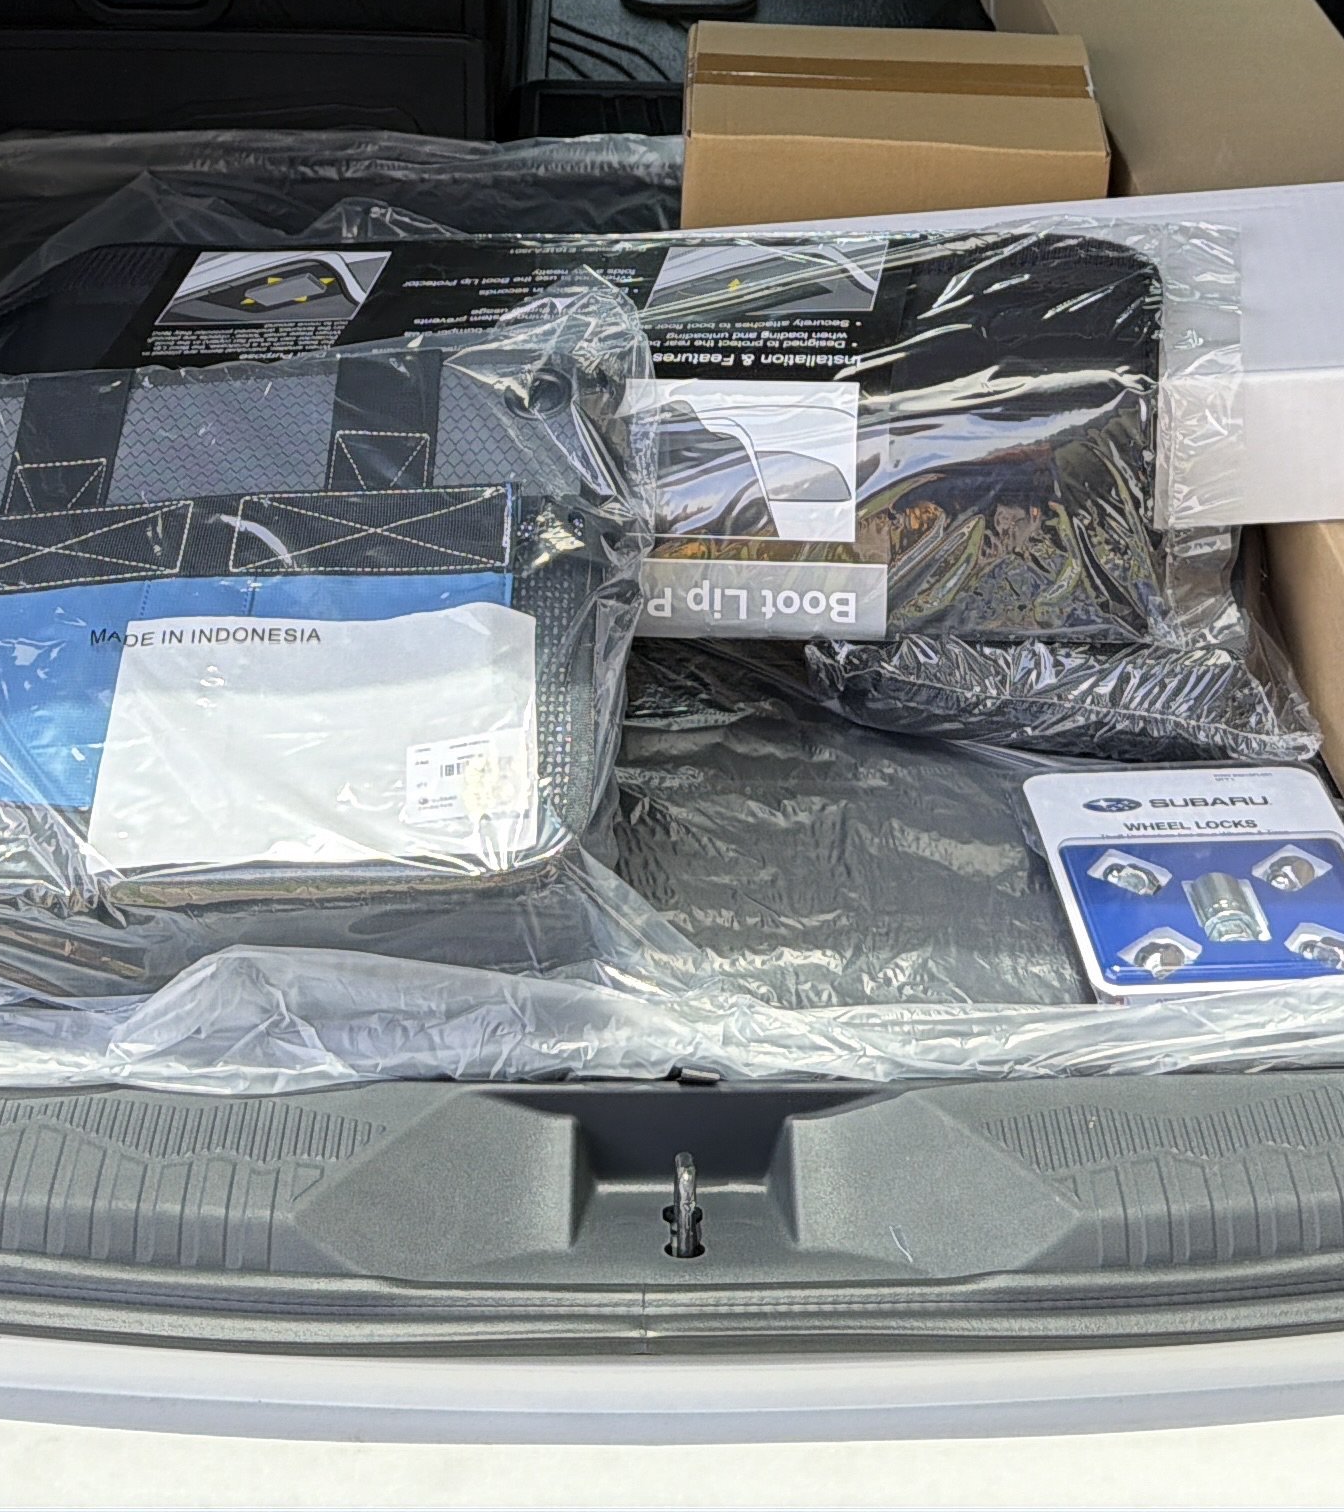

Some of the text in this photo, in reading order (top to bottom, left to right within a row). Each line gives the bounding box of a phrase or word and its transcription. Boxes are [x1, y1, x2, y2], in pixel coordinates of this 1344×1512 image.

[401, 279, 457, 288] Protector
[461, 278, 479, 286] Lip
[481, 277, 510, 285] Boot
[513, 275, 533, 283] the
[478, 287, 529, 296] seconds
[413, 315, 467, 324] prevents
[734, 320, 790, 328] attaches
[793, 319, 850, 328] Securely
[665, 332, 729, 340] unloading
[732, 331, 758, 340] and
[760, 330, 808, 339] loading
[693, 339, 714, 347] the
[718, 339, 763, 348] protect
[767, 340, 779, 348] to
[782, 339, 846, 348] Designed
[652, 353, 861, 368] Installation & Features
[686, 579, 749, 620] Lip
[761, 589, 858, 624] Boot
[89, 627, 321, 648] MADE IN INDONESIA
[1149, 795, 1270, 808] SUBARU
[1123, 819, 1258, 832] WHEEL LOCKS
